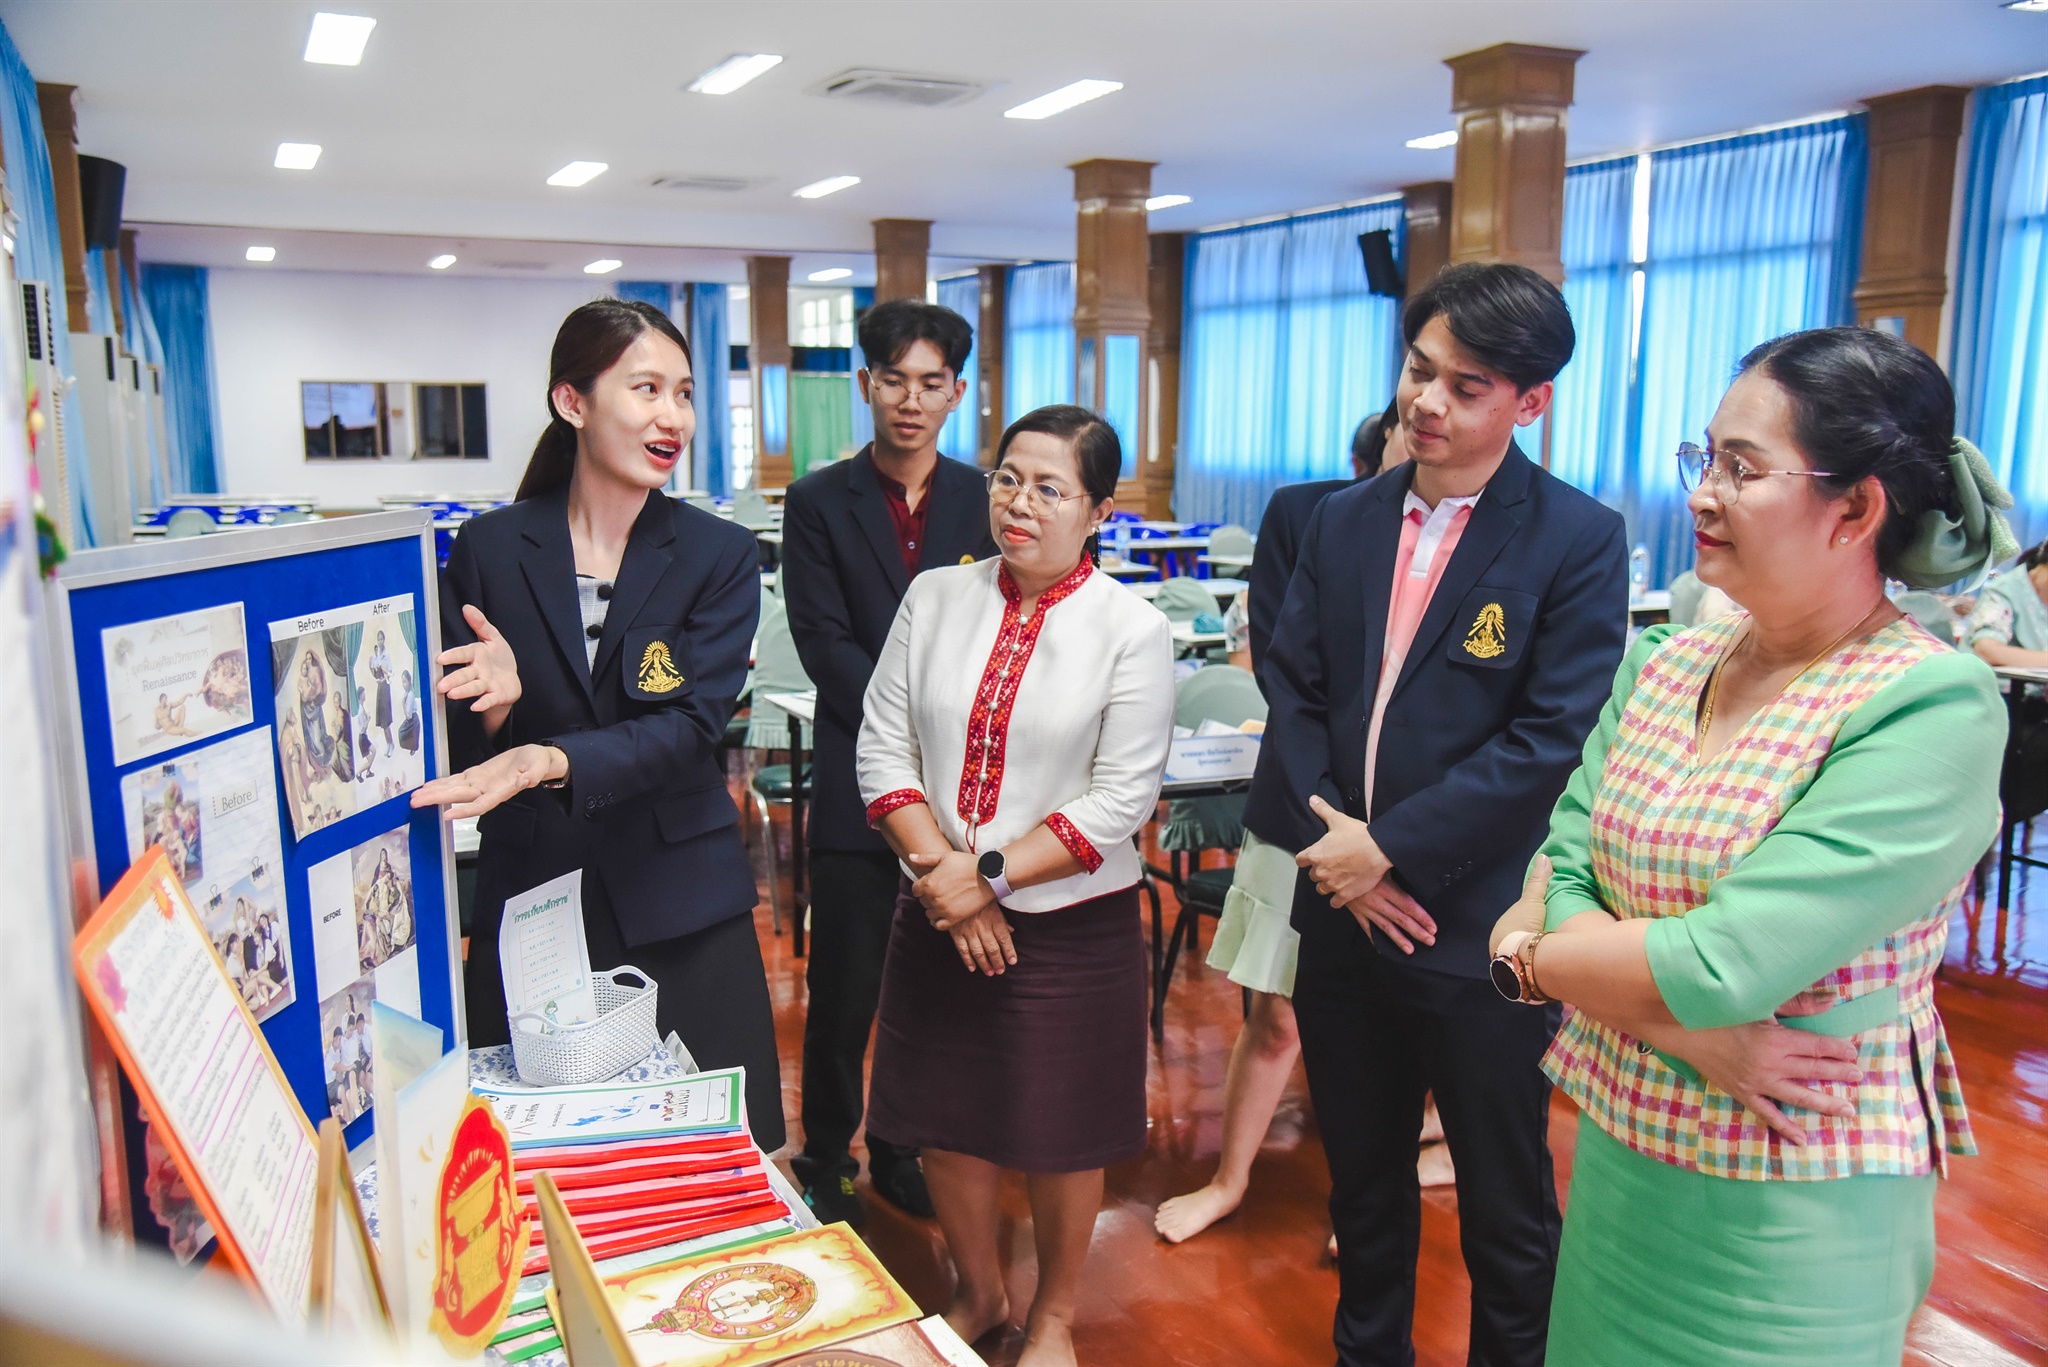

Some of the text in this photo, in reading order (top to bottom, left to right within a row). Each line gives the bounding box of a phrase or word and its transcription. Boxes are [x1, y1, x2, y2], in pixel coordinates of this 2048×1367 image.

[297, 602, 391, 632] Before After
[142, 669, 198, 692] Renaissance
[221, 791, 253, 812] Before
[323, 908, 342, 924] BEFORE
